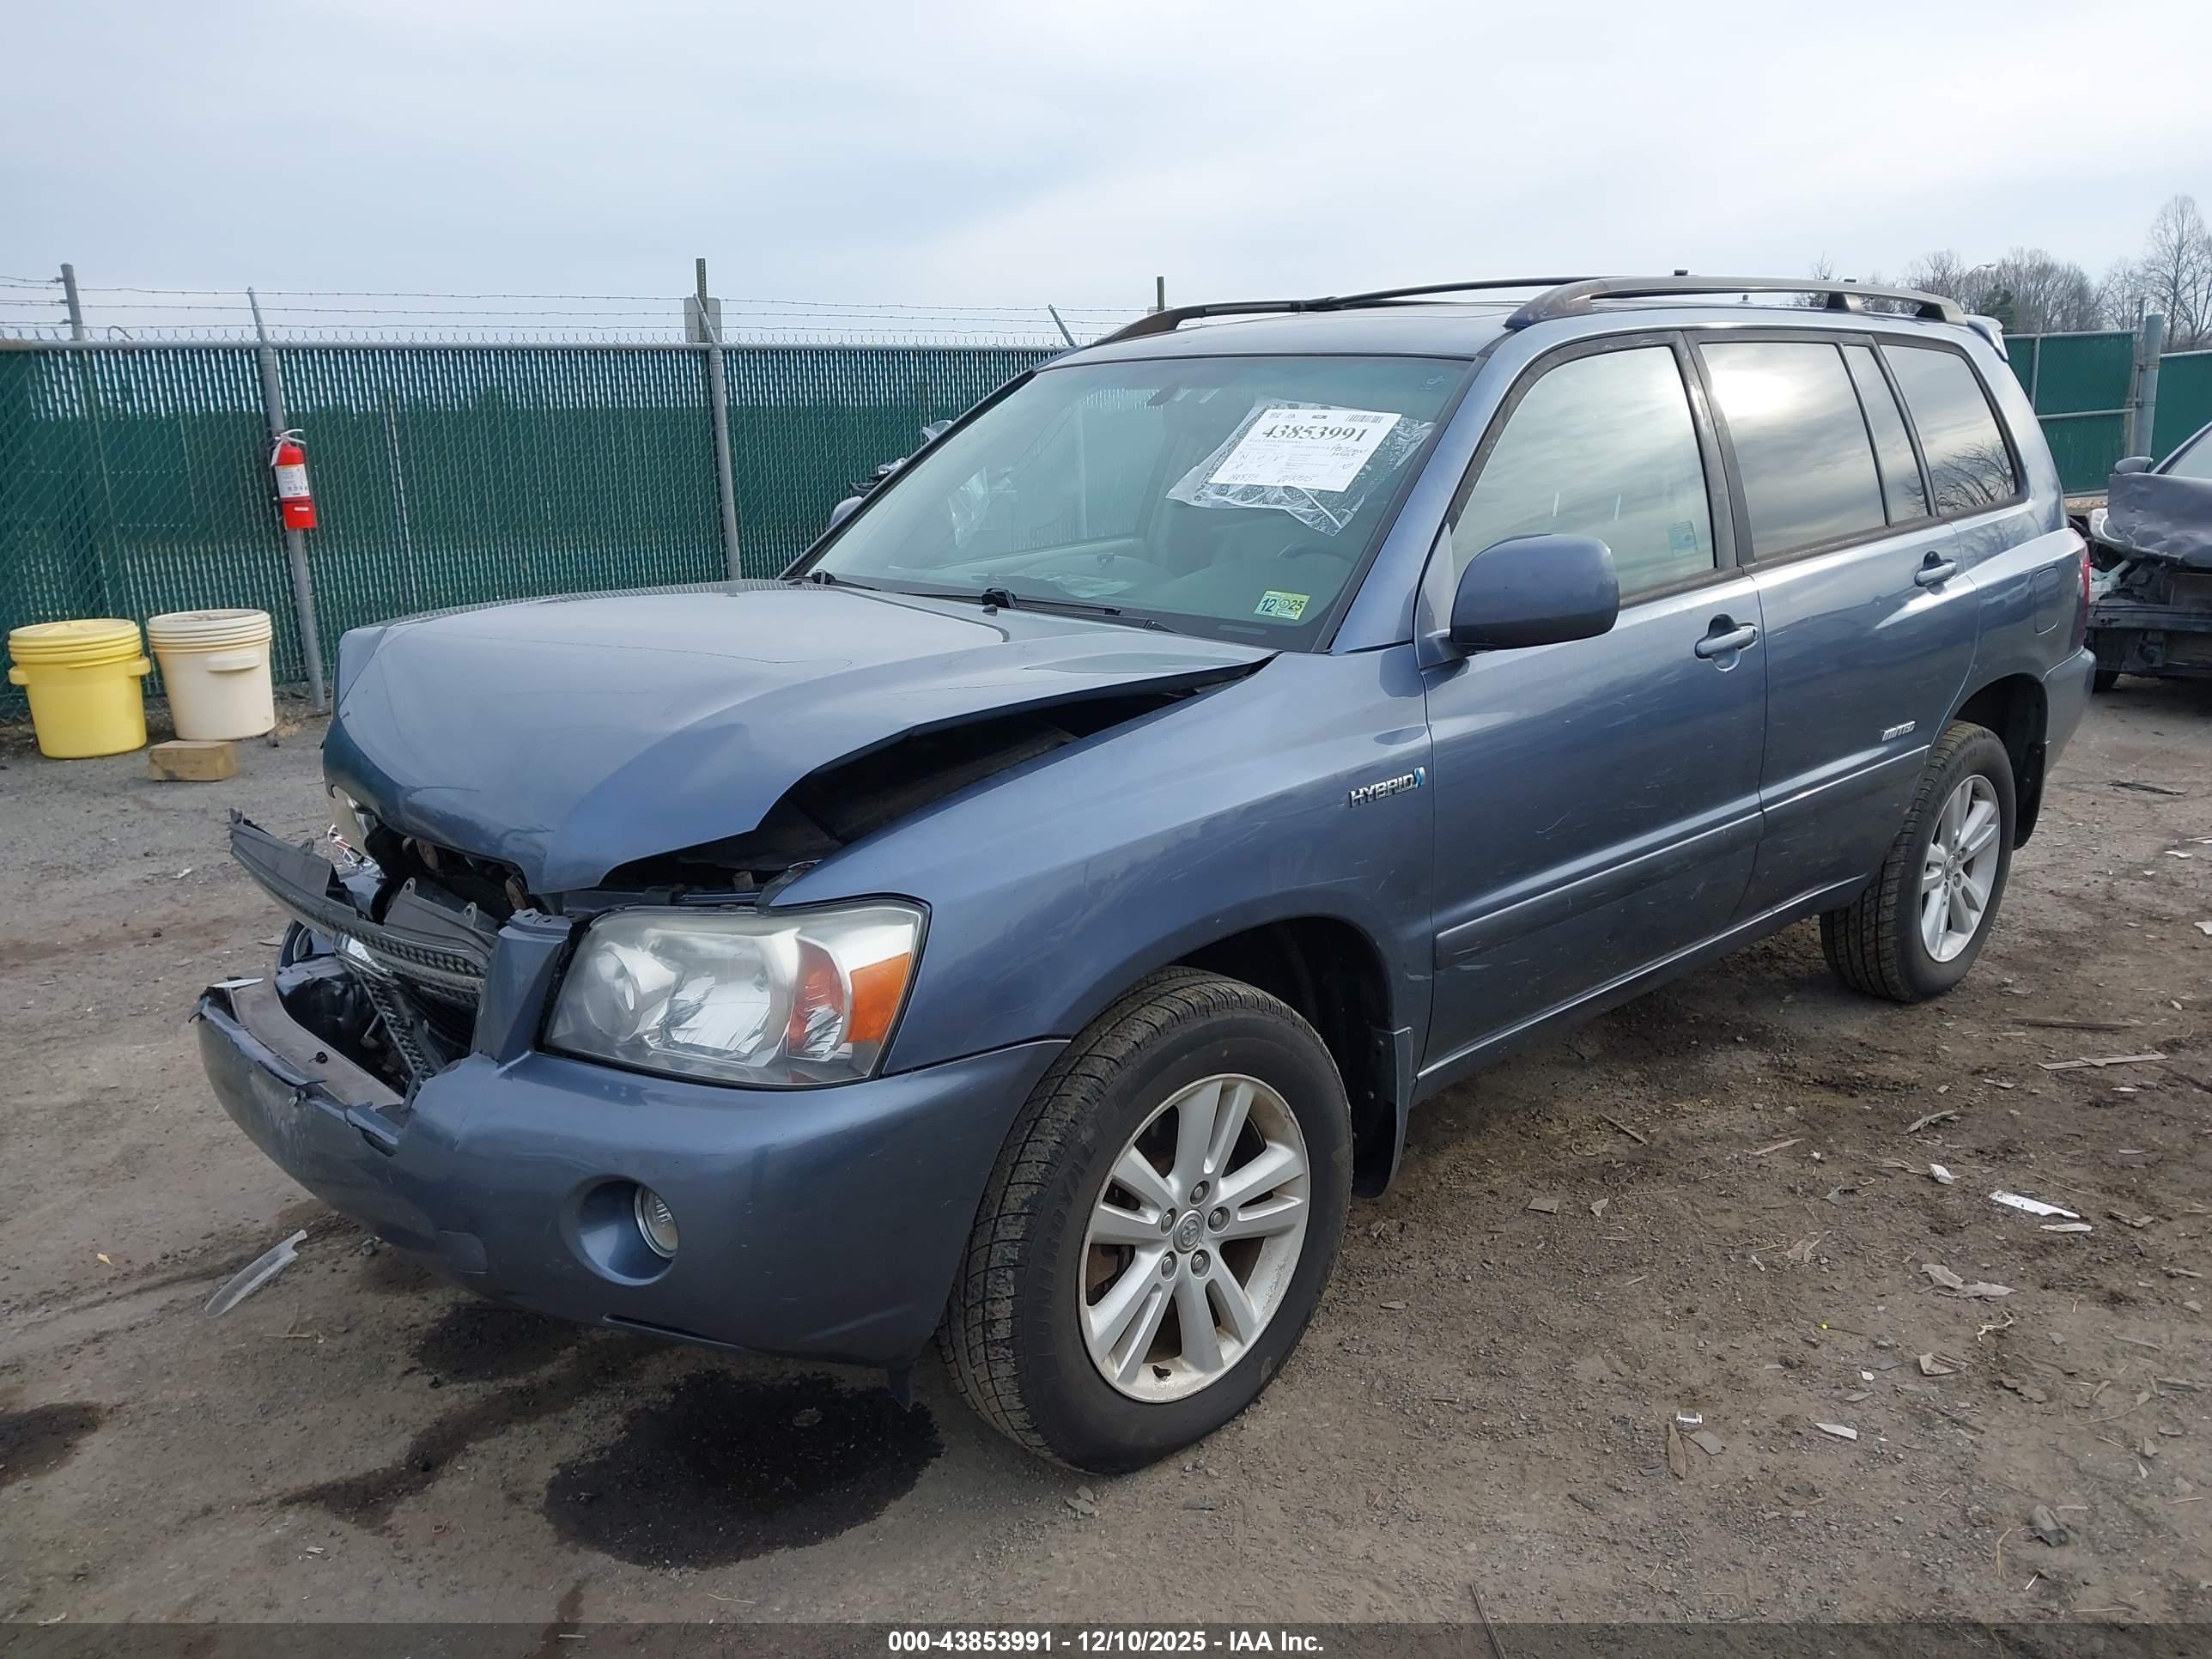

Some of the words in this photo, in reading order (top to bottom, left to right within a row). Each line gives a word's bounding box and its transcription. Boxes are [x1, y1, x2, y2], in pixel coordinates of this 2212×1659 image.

[1261, 424, 1369, 442] 43853991
[1261, 598, 1277, 612] 12
[1288, 599, 1305, 611] 25
[1349, 774, 1416, 807] HYBRID
